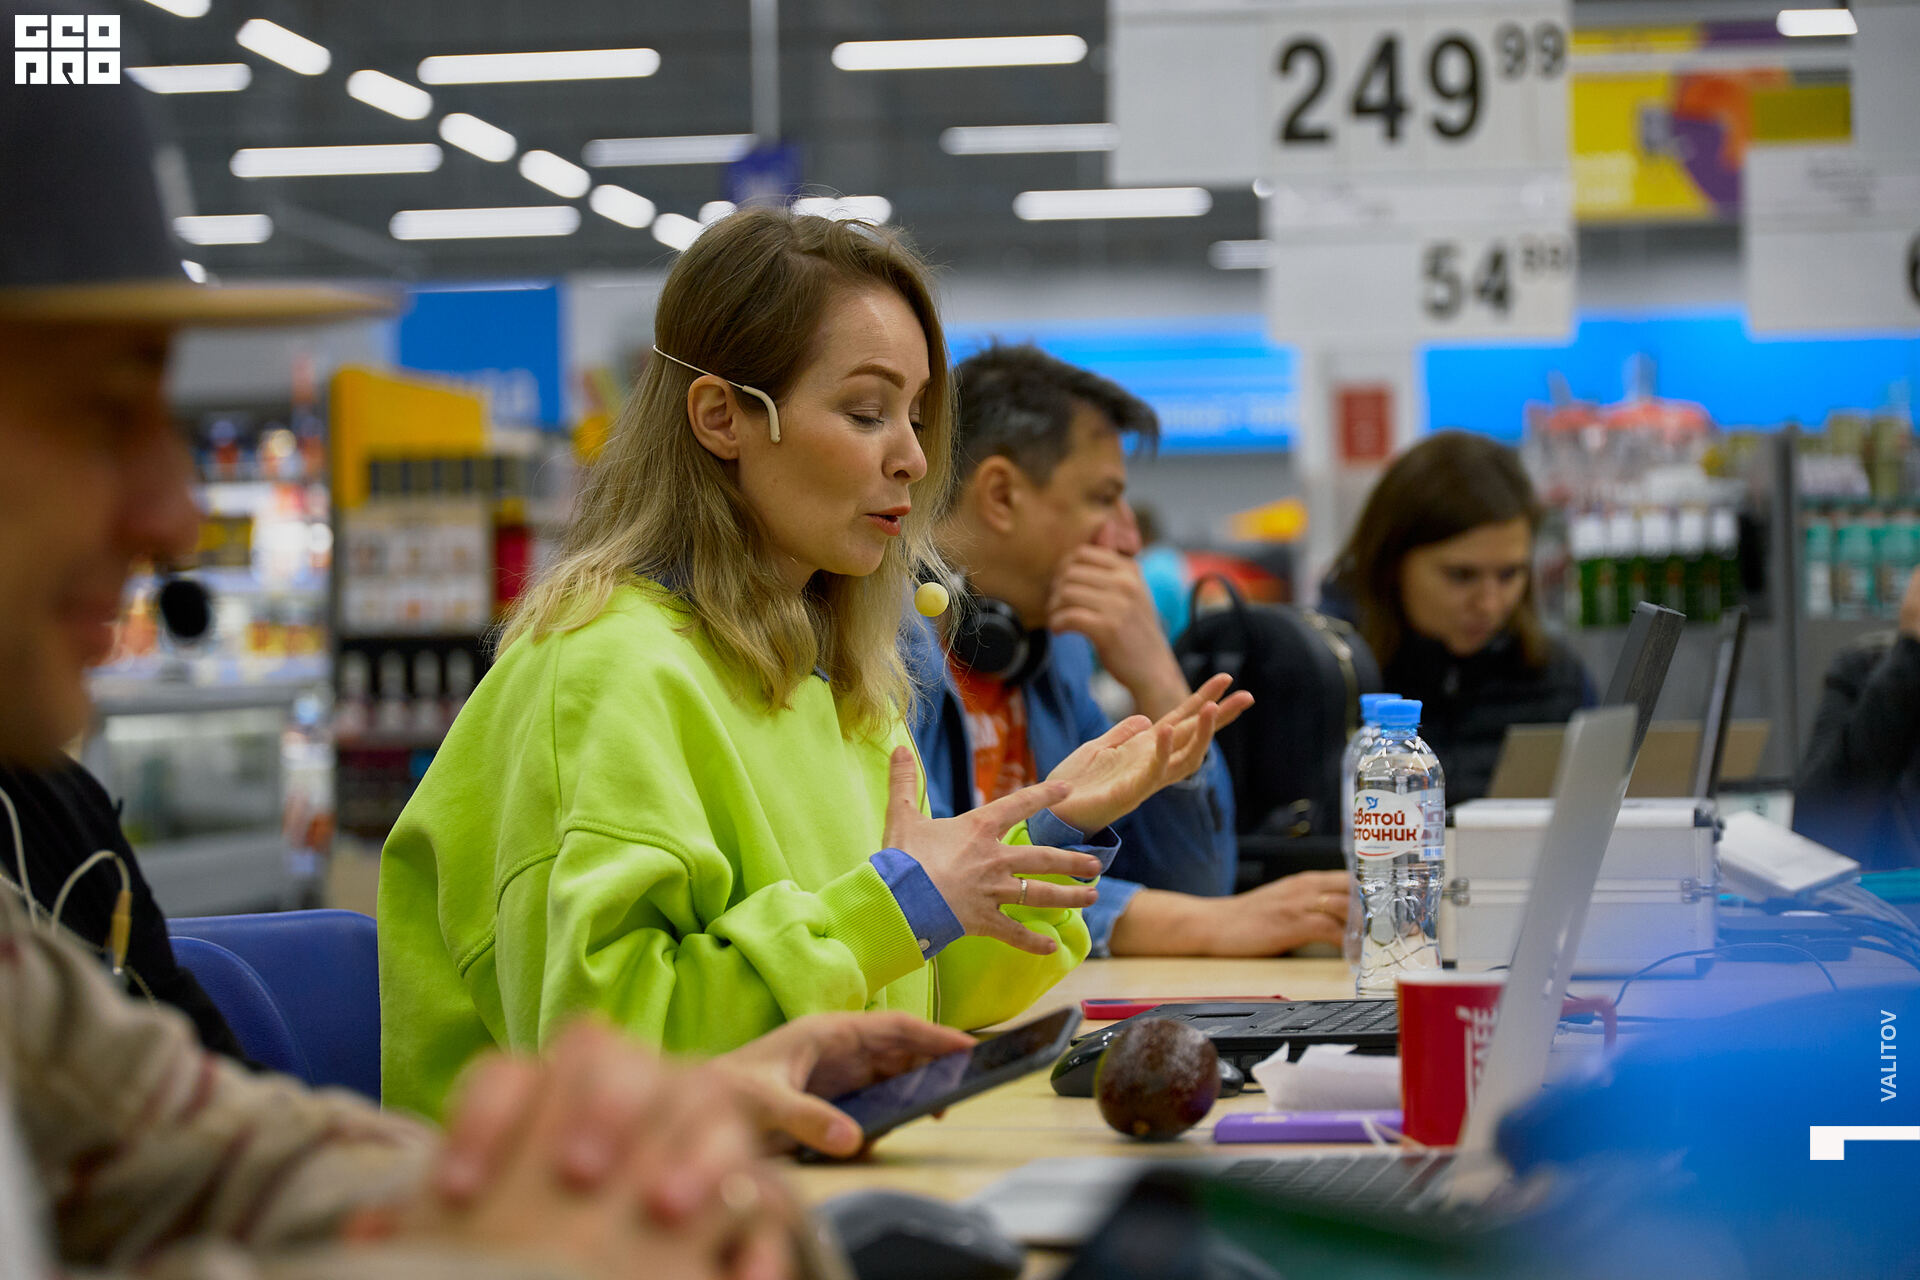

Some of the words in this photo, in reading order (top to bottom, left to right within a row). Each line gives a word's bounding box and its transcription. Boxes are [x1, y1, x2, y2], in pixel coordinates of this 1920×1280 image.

[1277, 34, 1484, 144] 249
[1496, 23, 1566, 80] 99
[1422, 240, 1512, 320] 54
